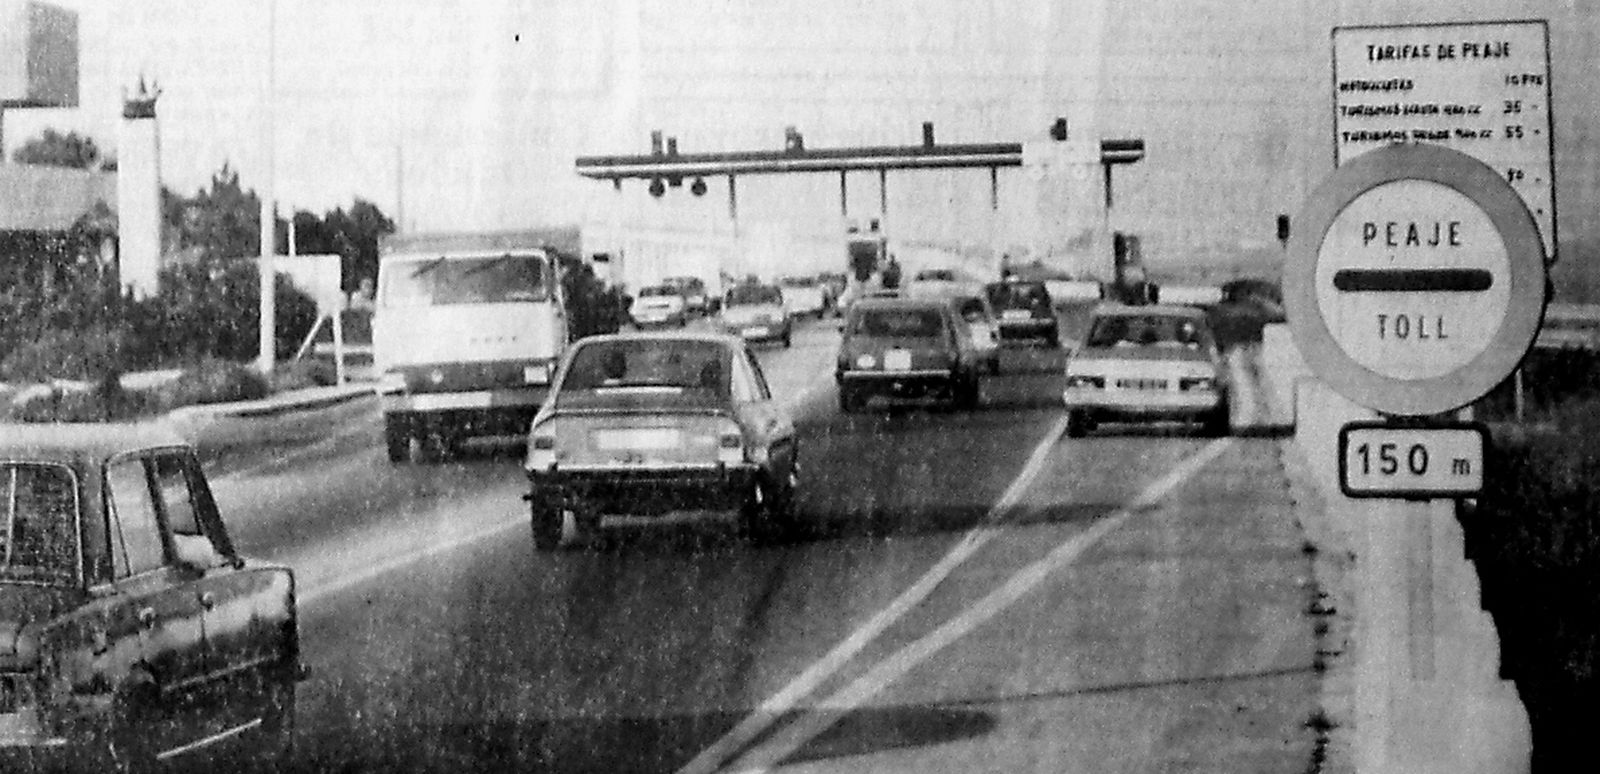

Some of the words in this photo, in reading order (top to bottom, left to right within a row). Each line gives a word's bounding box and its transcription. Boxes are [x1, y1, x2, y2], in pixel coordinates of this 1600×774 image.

[1367, 44, 1430, 61] TARIFAS
[1438, 44, 1455, 59] DE
[1462, 42, 1511, 58] PEAJE
[1363, 222, 1461, 246] PEAJE
[1377, 314, 1449, 339] TOLL
[1357, 443, 1430, 476] 150
[1451, 458, 1471, 476] m
